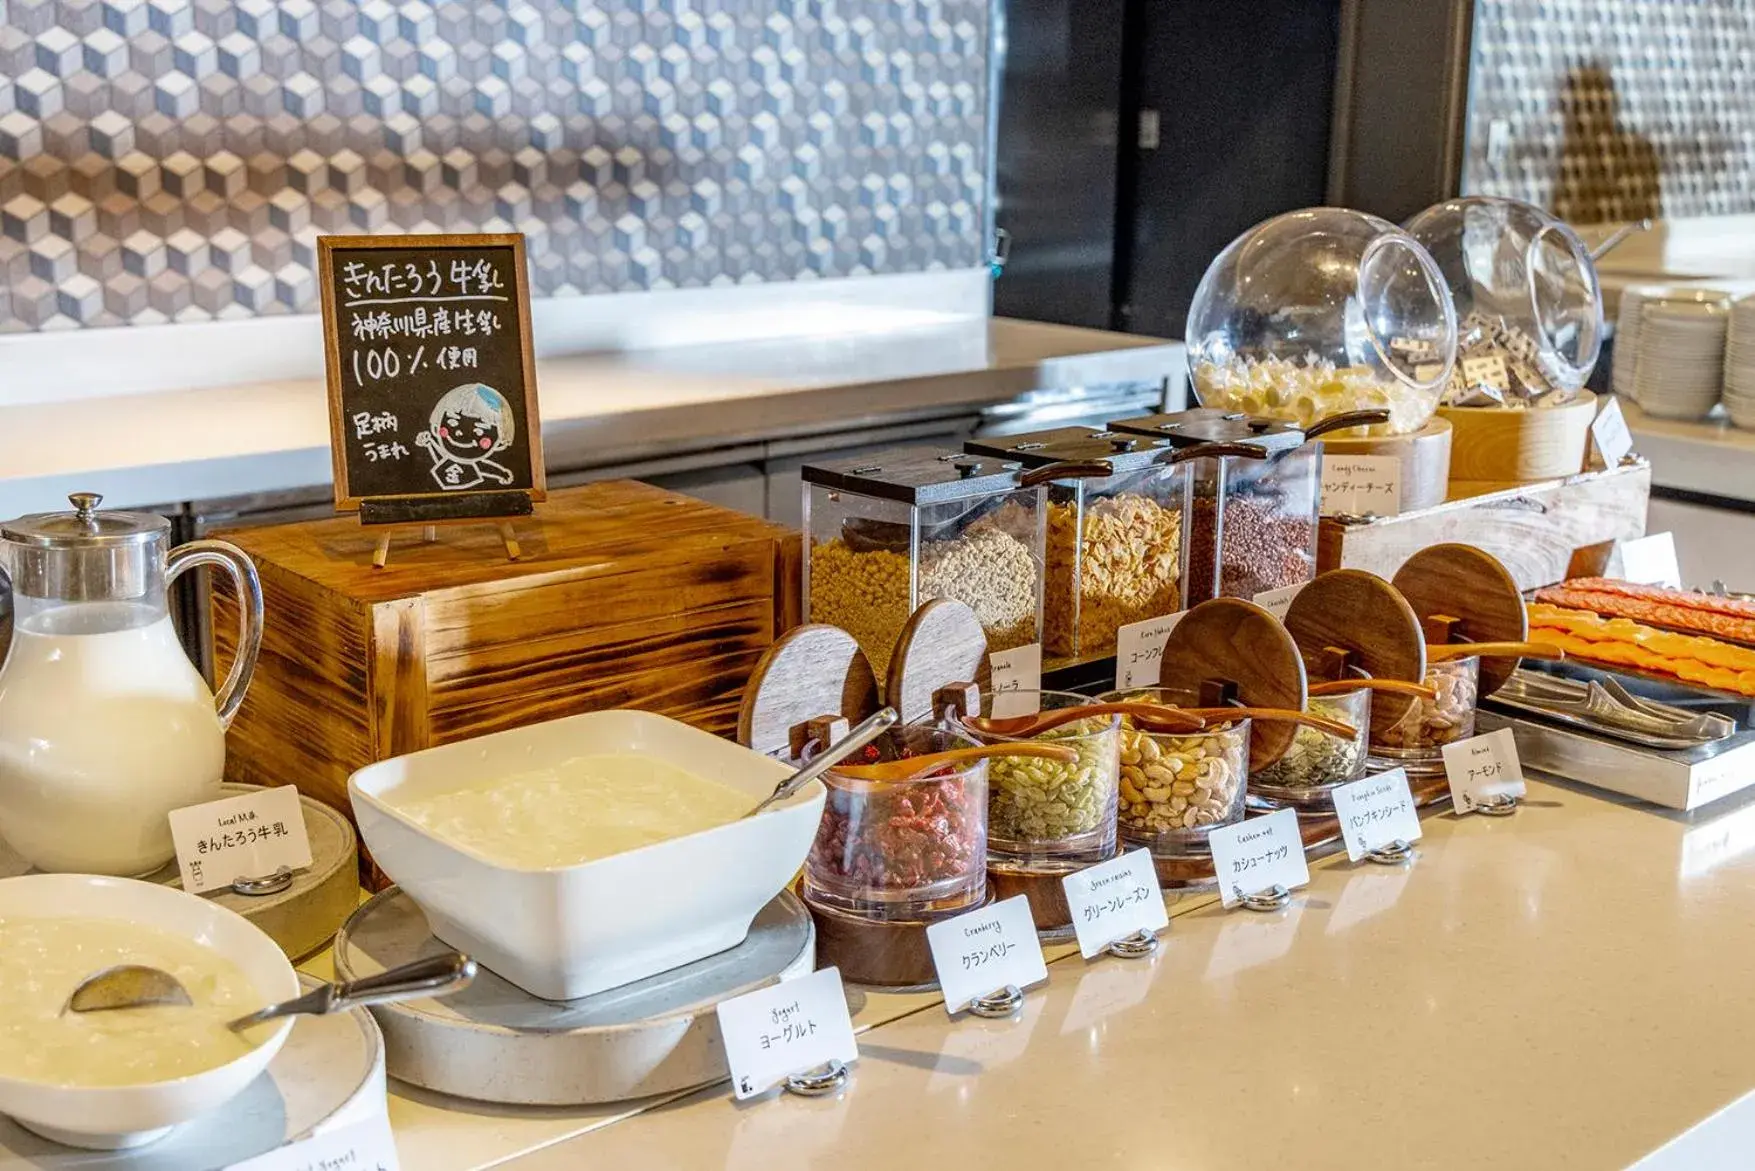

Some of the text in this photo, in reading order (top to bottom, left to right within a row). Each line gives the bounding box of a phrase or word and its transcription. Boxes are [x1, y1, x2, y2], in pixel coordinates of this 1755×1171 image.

[344, 259, 504, 298] きんたろう牛乳
[352, 307, 501, 341] 神奈川県産生乳
[363, 442, 410, 462] うまれ
[1324, 481, 1394, 495] ャンディーチーズ
[1467, 762, 1503, 781] アーモンド
[218, 814, 237, 827] Local
[197, 822, 289, 854] きんたろう牛乳
[1232, 845, 1289, 873] カシューナッツ
[1083, 887, 1150, 922] グリーンレーズン
[962, 942, 1016, 970] クランベリー
[760, 1020, 817, 1049] ヨーグルト
